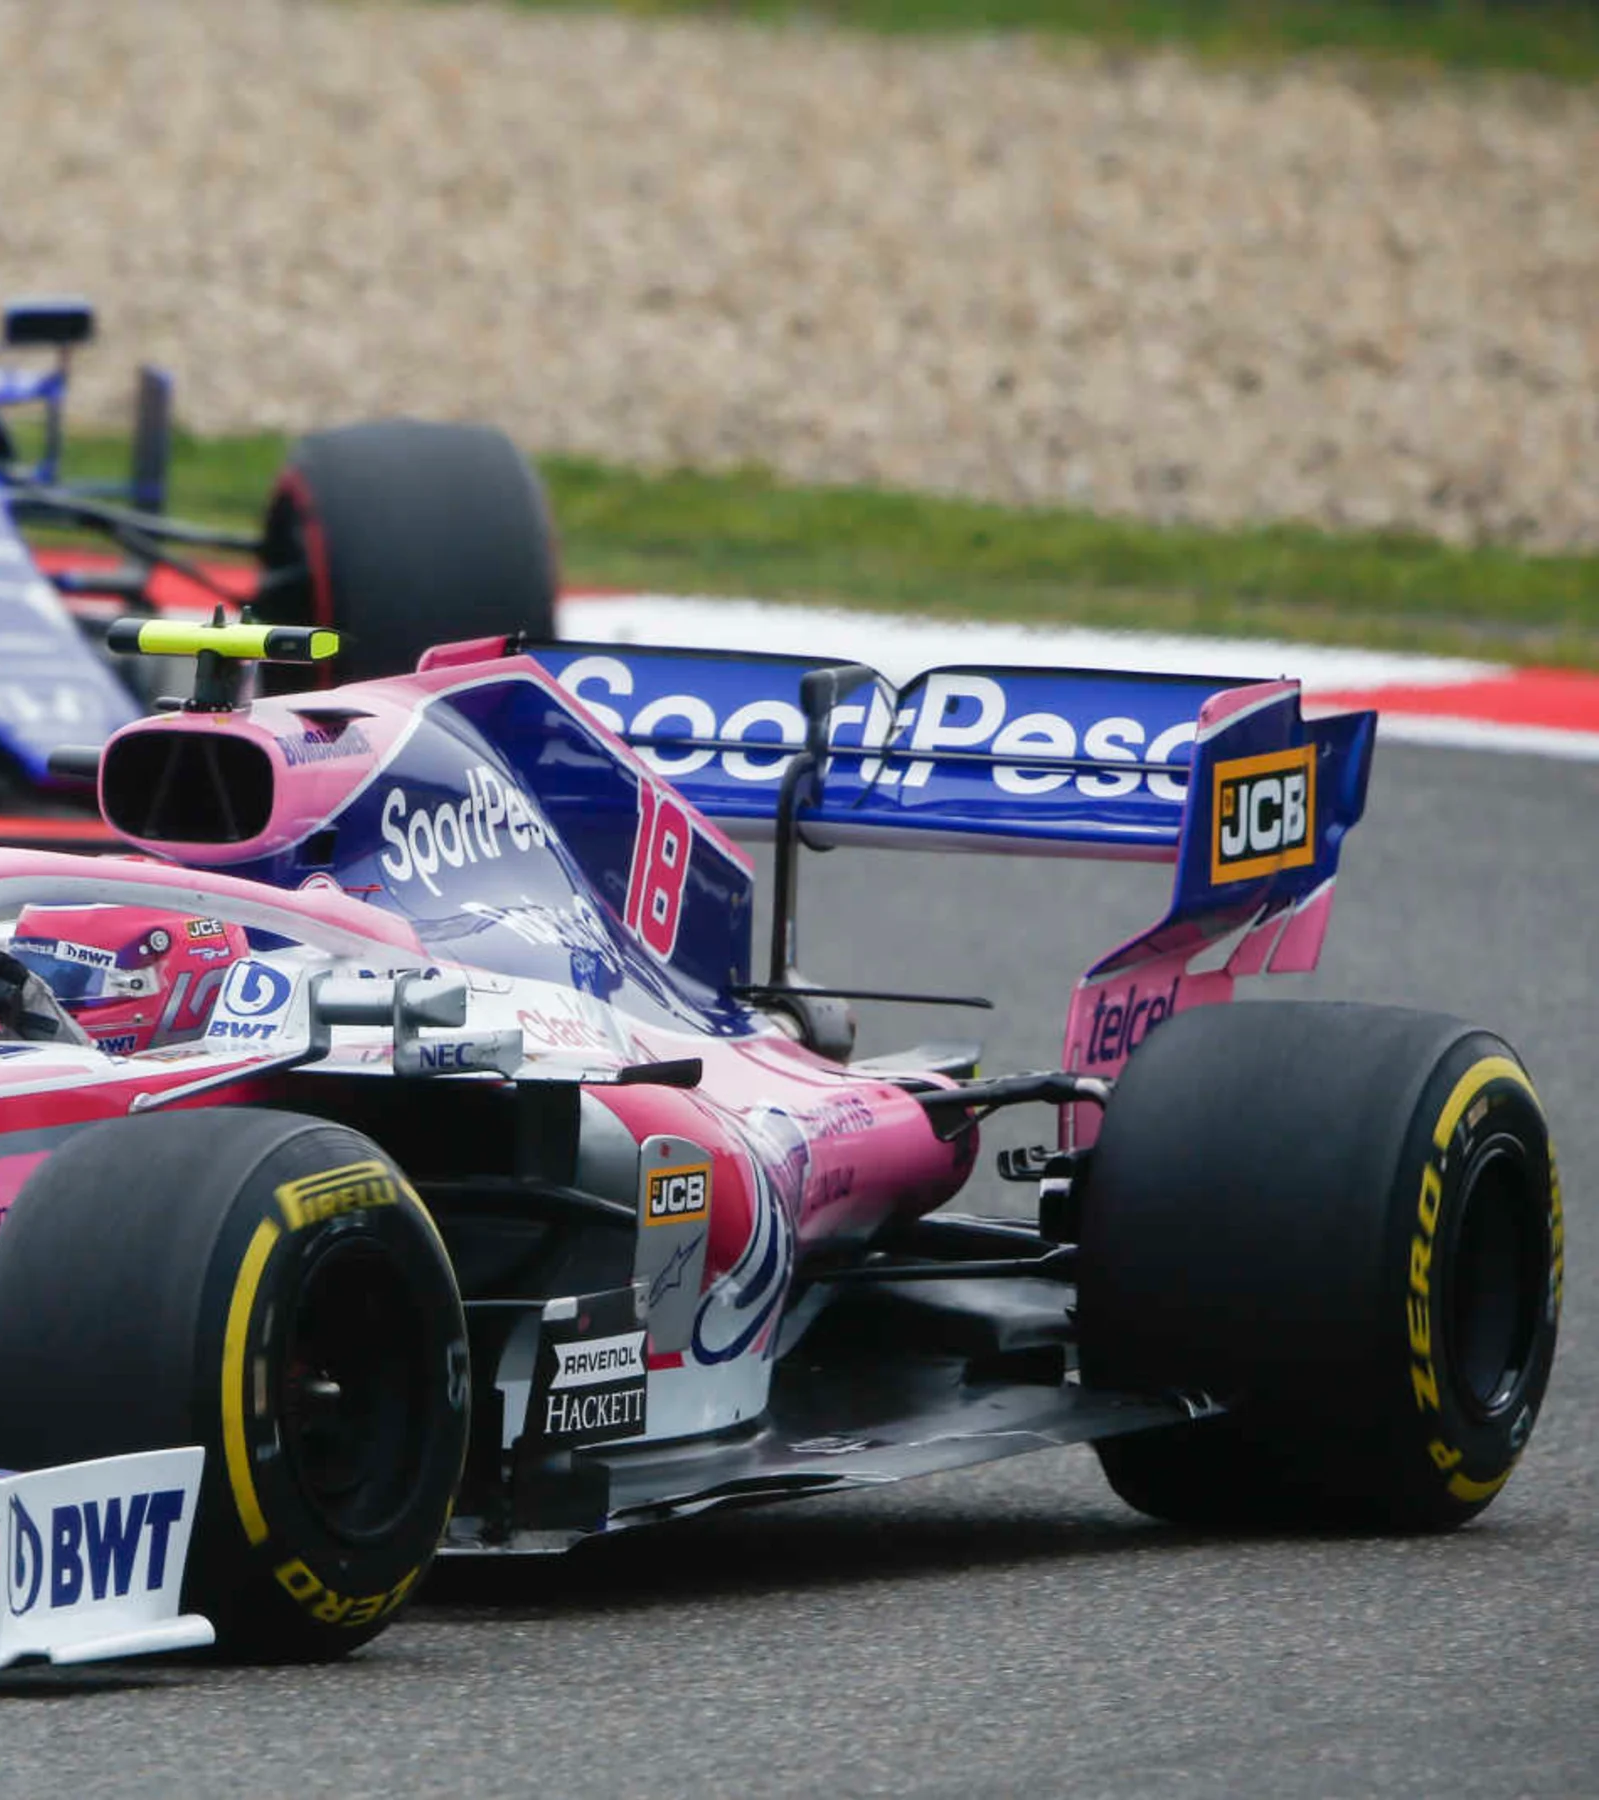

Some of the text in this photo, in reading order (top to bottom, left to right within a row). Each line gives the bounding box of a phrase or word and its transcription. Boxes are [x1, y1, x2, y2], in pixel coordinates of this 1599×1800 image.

[1220, 772, 1307, 857] JCB
[624, 776, 691, 963] 18
[78, 950, 114, 967] BWT
[207, 1020, 279, 1041] BWT
[420, 1042, 476, 1068] NEC
[273, 1160, 399, 1232] PIRELLI
[651, 1170, 706, 1215] JCB
[1407, 1162, 1442, 1412] ZERO
[564, 1344, 637, 1375] RAVENOL
[544, 1388, 646, 1433] HACKETT
[50, 1490, 186, 1608] BWT
[275, 1556, 421, 1627] ZERO
